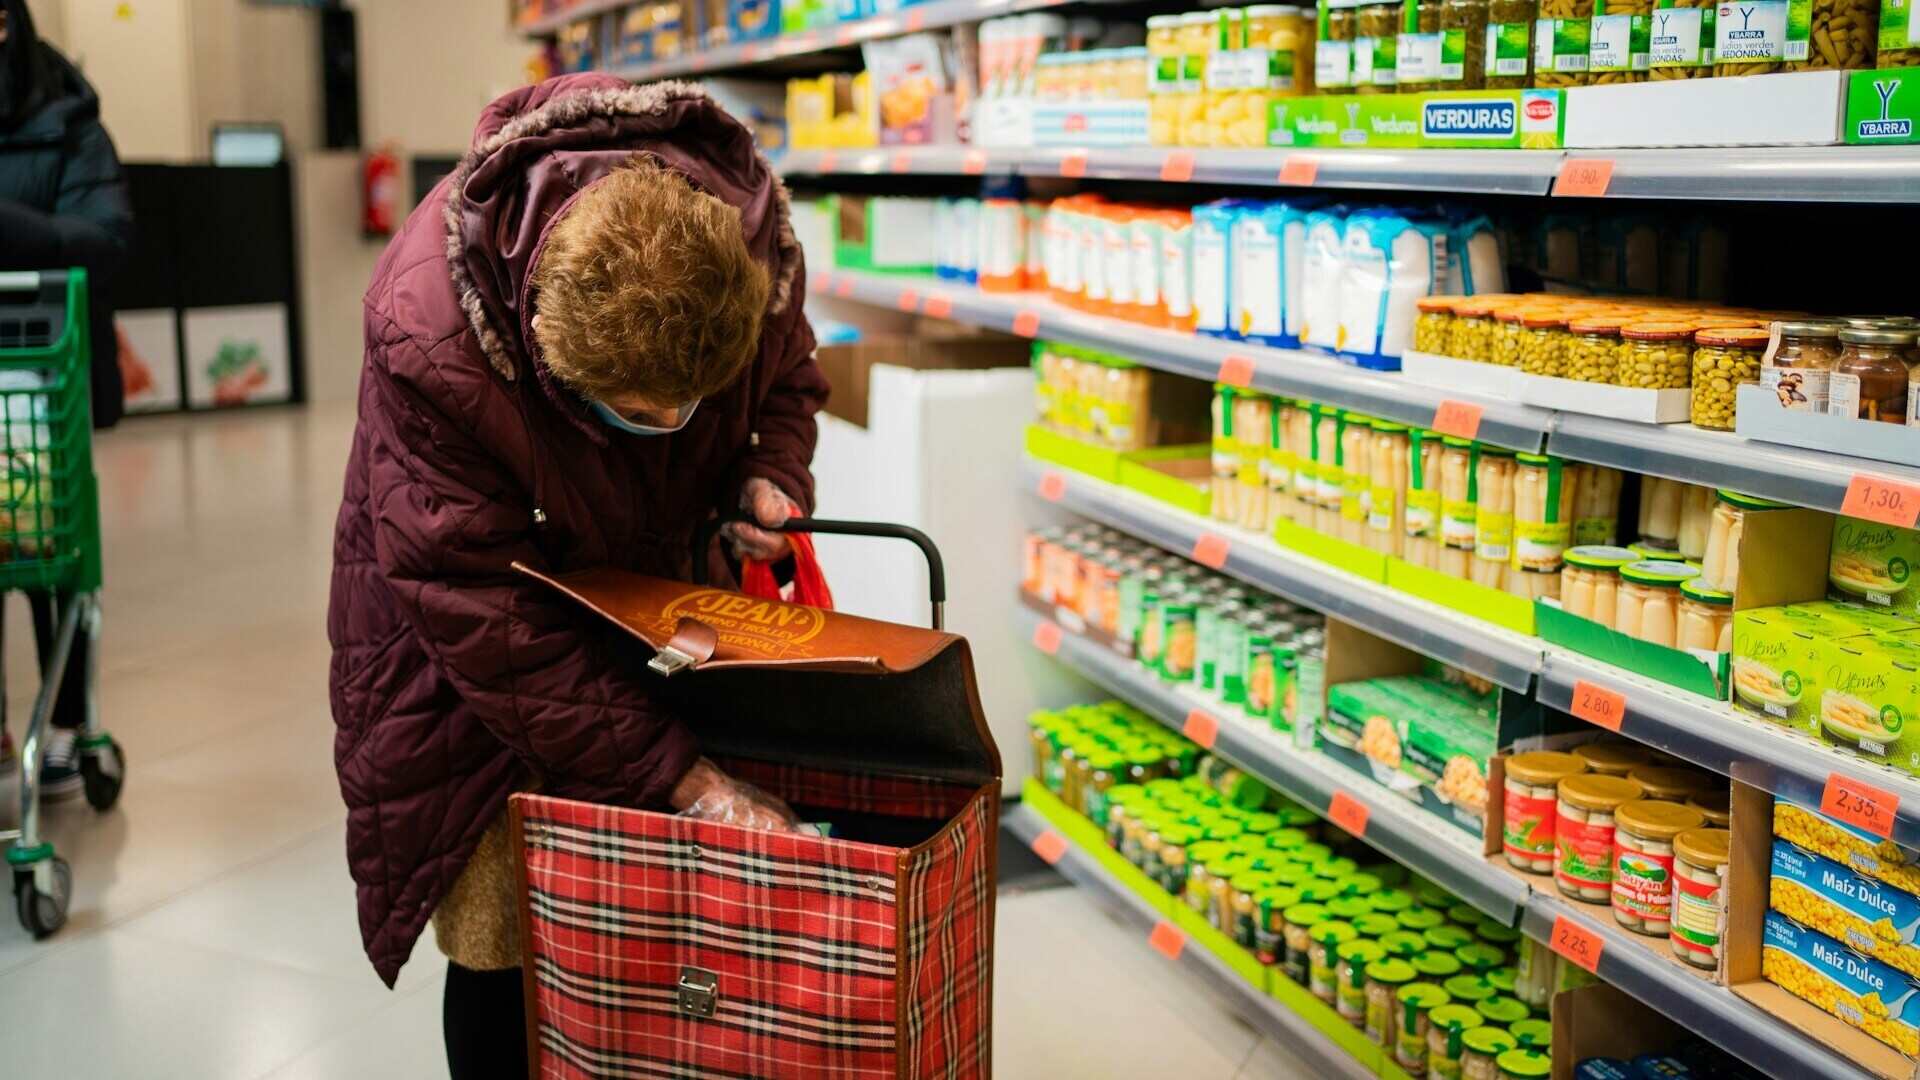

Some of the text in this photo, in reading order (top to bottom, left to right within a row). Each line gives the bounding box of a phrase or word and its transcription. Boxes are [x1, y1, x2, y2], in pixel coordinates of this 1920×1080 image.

[1729, 31, 1764, 39] YBARRA
[1722, 49, 1771, 58] REDONDAS
[1426, 108, 1513, 129] VERDURAS
[1862, 122, 1908, 135] YBARRA
[740, 622, 796, 641] TROLLEY
[1822, 870, 1897, 916] Maíz Dulce
[1813, 942, 1885, 990] Maíz Dulce
